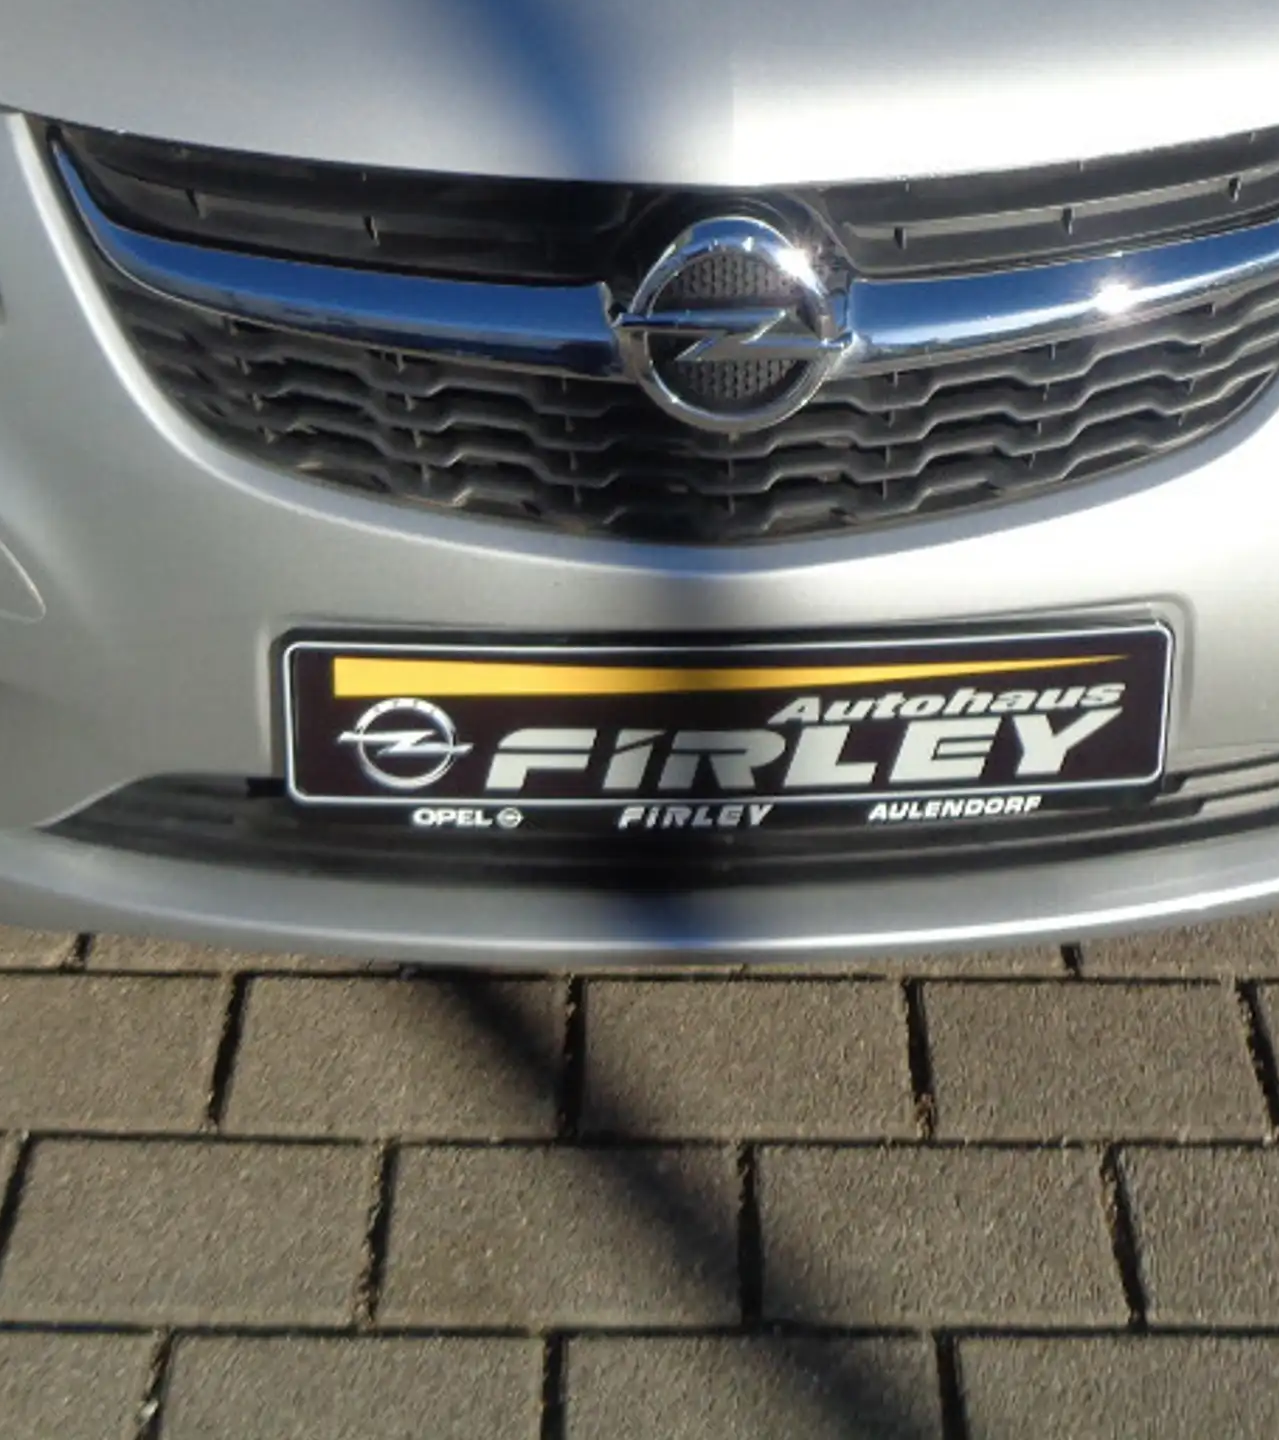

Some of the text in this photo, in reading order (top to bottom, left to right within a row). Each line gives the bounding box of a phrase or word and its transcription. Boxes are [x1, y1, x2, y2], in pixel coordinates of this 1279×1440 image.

[767, 682, 1126, 725] Autohaus
[484, 707, 1123, 789] FIRLEY
[412, 808, 493, 826] OPEL
[617, 804, 773, 829] FIRLEY
[867, 795, 1042, 822] AULENDORF
